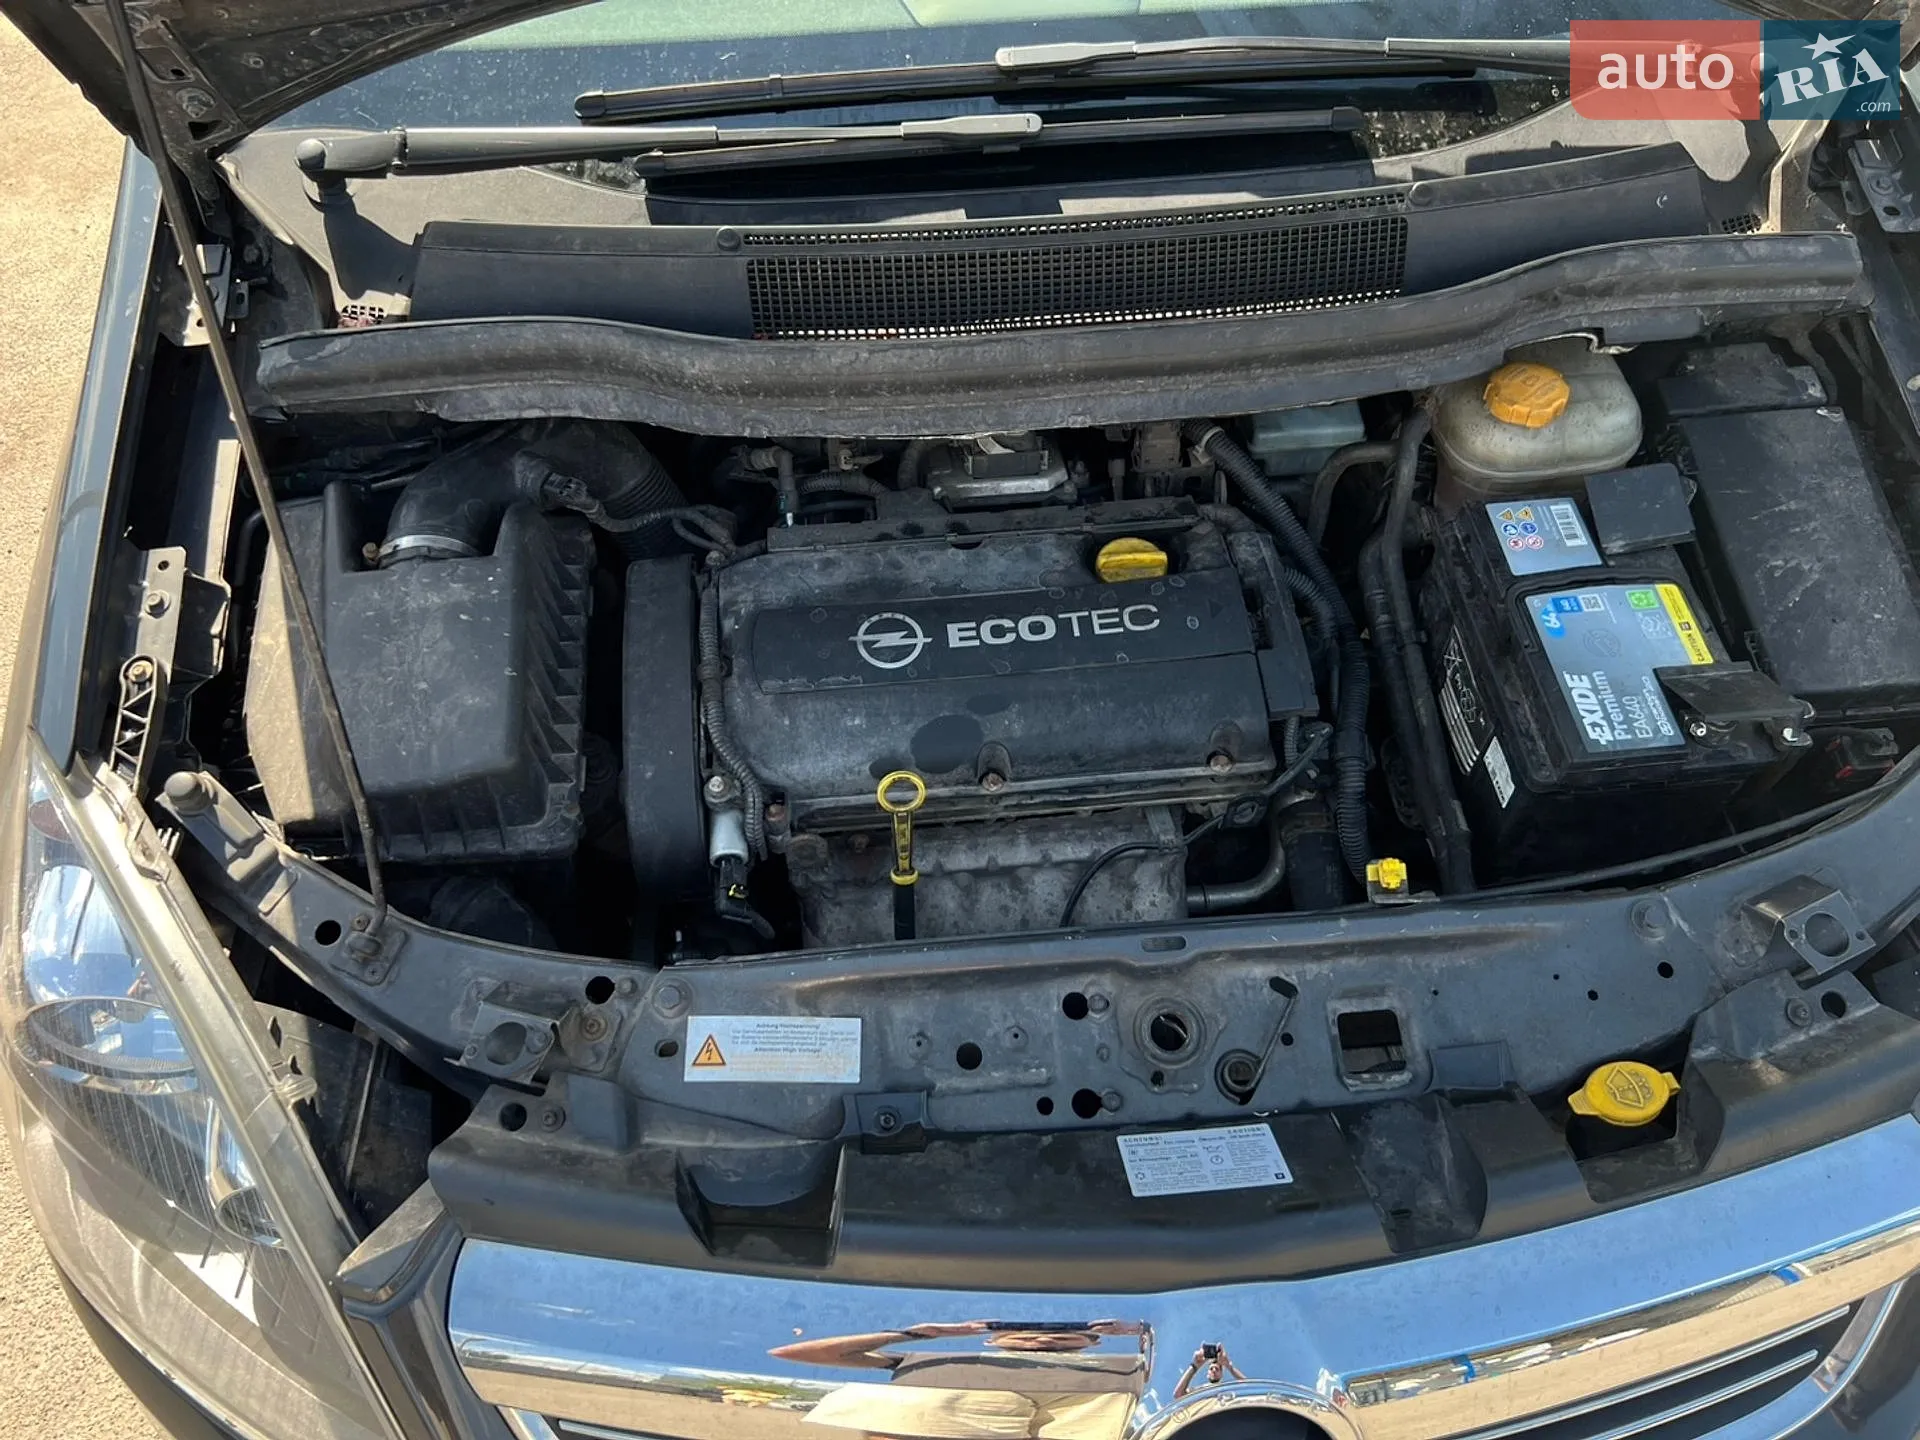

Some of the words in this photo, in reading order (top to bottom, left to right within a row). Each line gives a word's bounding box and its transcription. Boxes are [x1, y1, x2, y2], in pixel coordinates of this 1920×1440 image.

[947, 604, 1160, 648] ECOTEC
[1563, 671, 1613, 745] EXIDE
[1592, 671, 1632, 740] Premium
[1623, 695, 1653, 739] EA640
